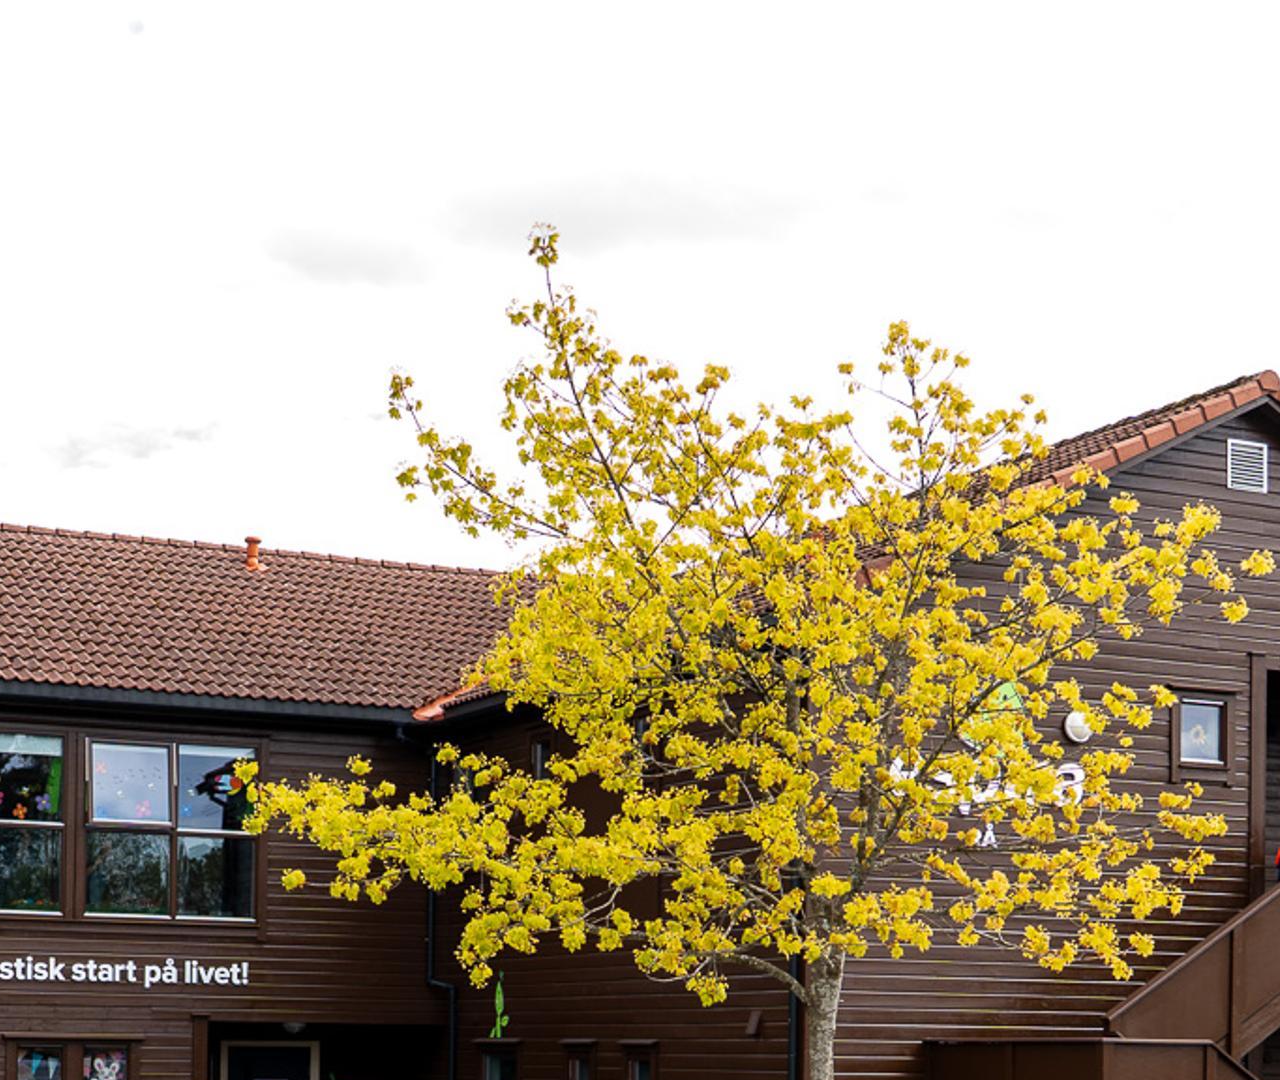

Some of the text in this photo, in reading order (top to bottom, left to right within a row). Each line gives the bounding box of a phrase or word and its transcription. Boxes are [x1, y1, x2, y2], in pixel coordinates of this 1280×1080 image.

[71, 959, 137, 983] start
[144, 957, 178, 988] på
[184, 960, 249, 985] livet!
